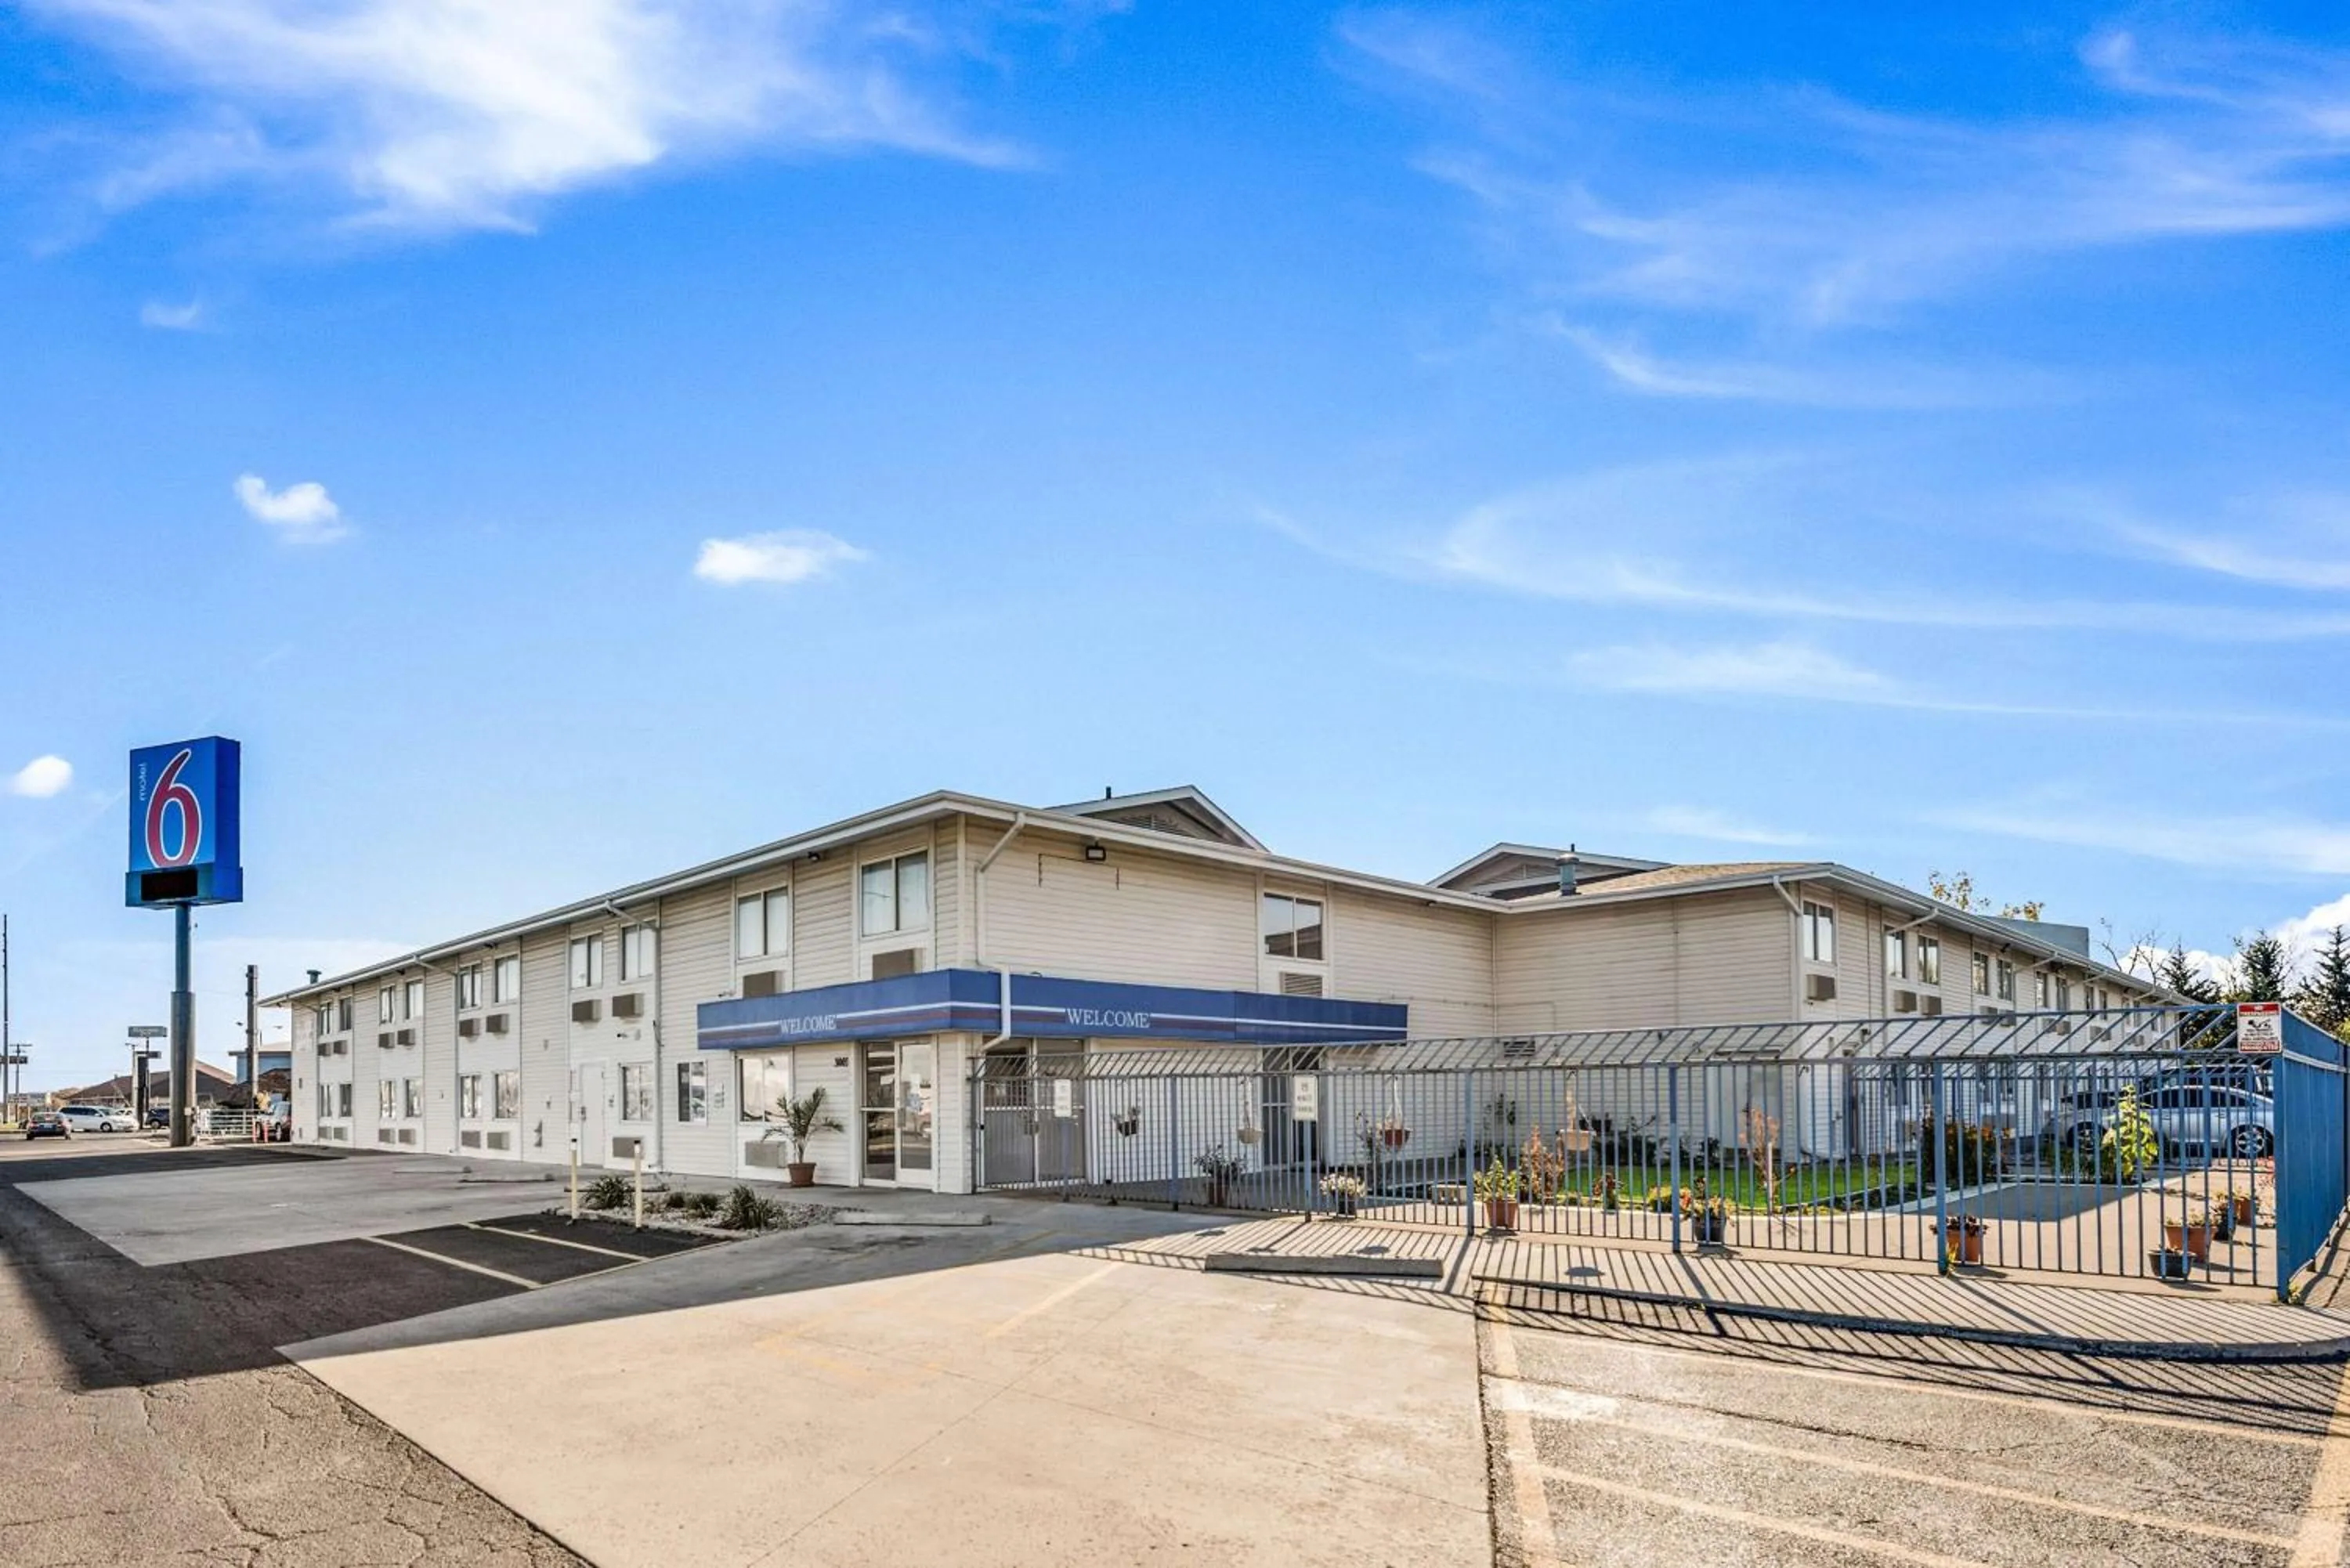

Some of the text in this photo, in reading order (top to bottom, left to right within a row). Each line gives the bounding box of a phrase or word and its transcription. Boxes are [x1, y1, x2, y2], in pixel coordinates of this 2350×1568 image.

[137, 748, 203, 869] motel 6
[779, 1014, 837, 1035] WELCOME
[1066, 1007, 1151, 1028] WELCOME
